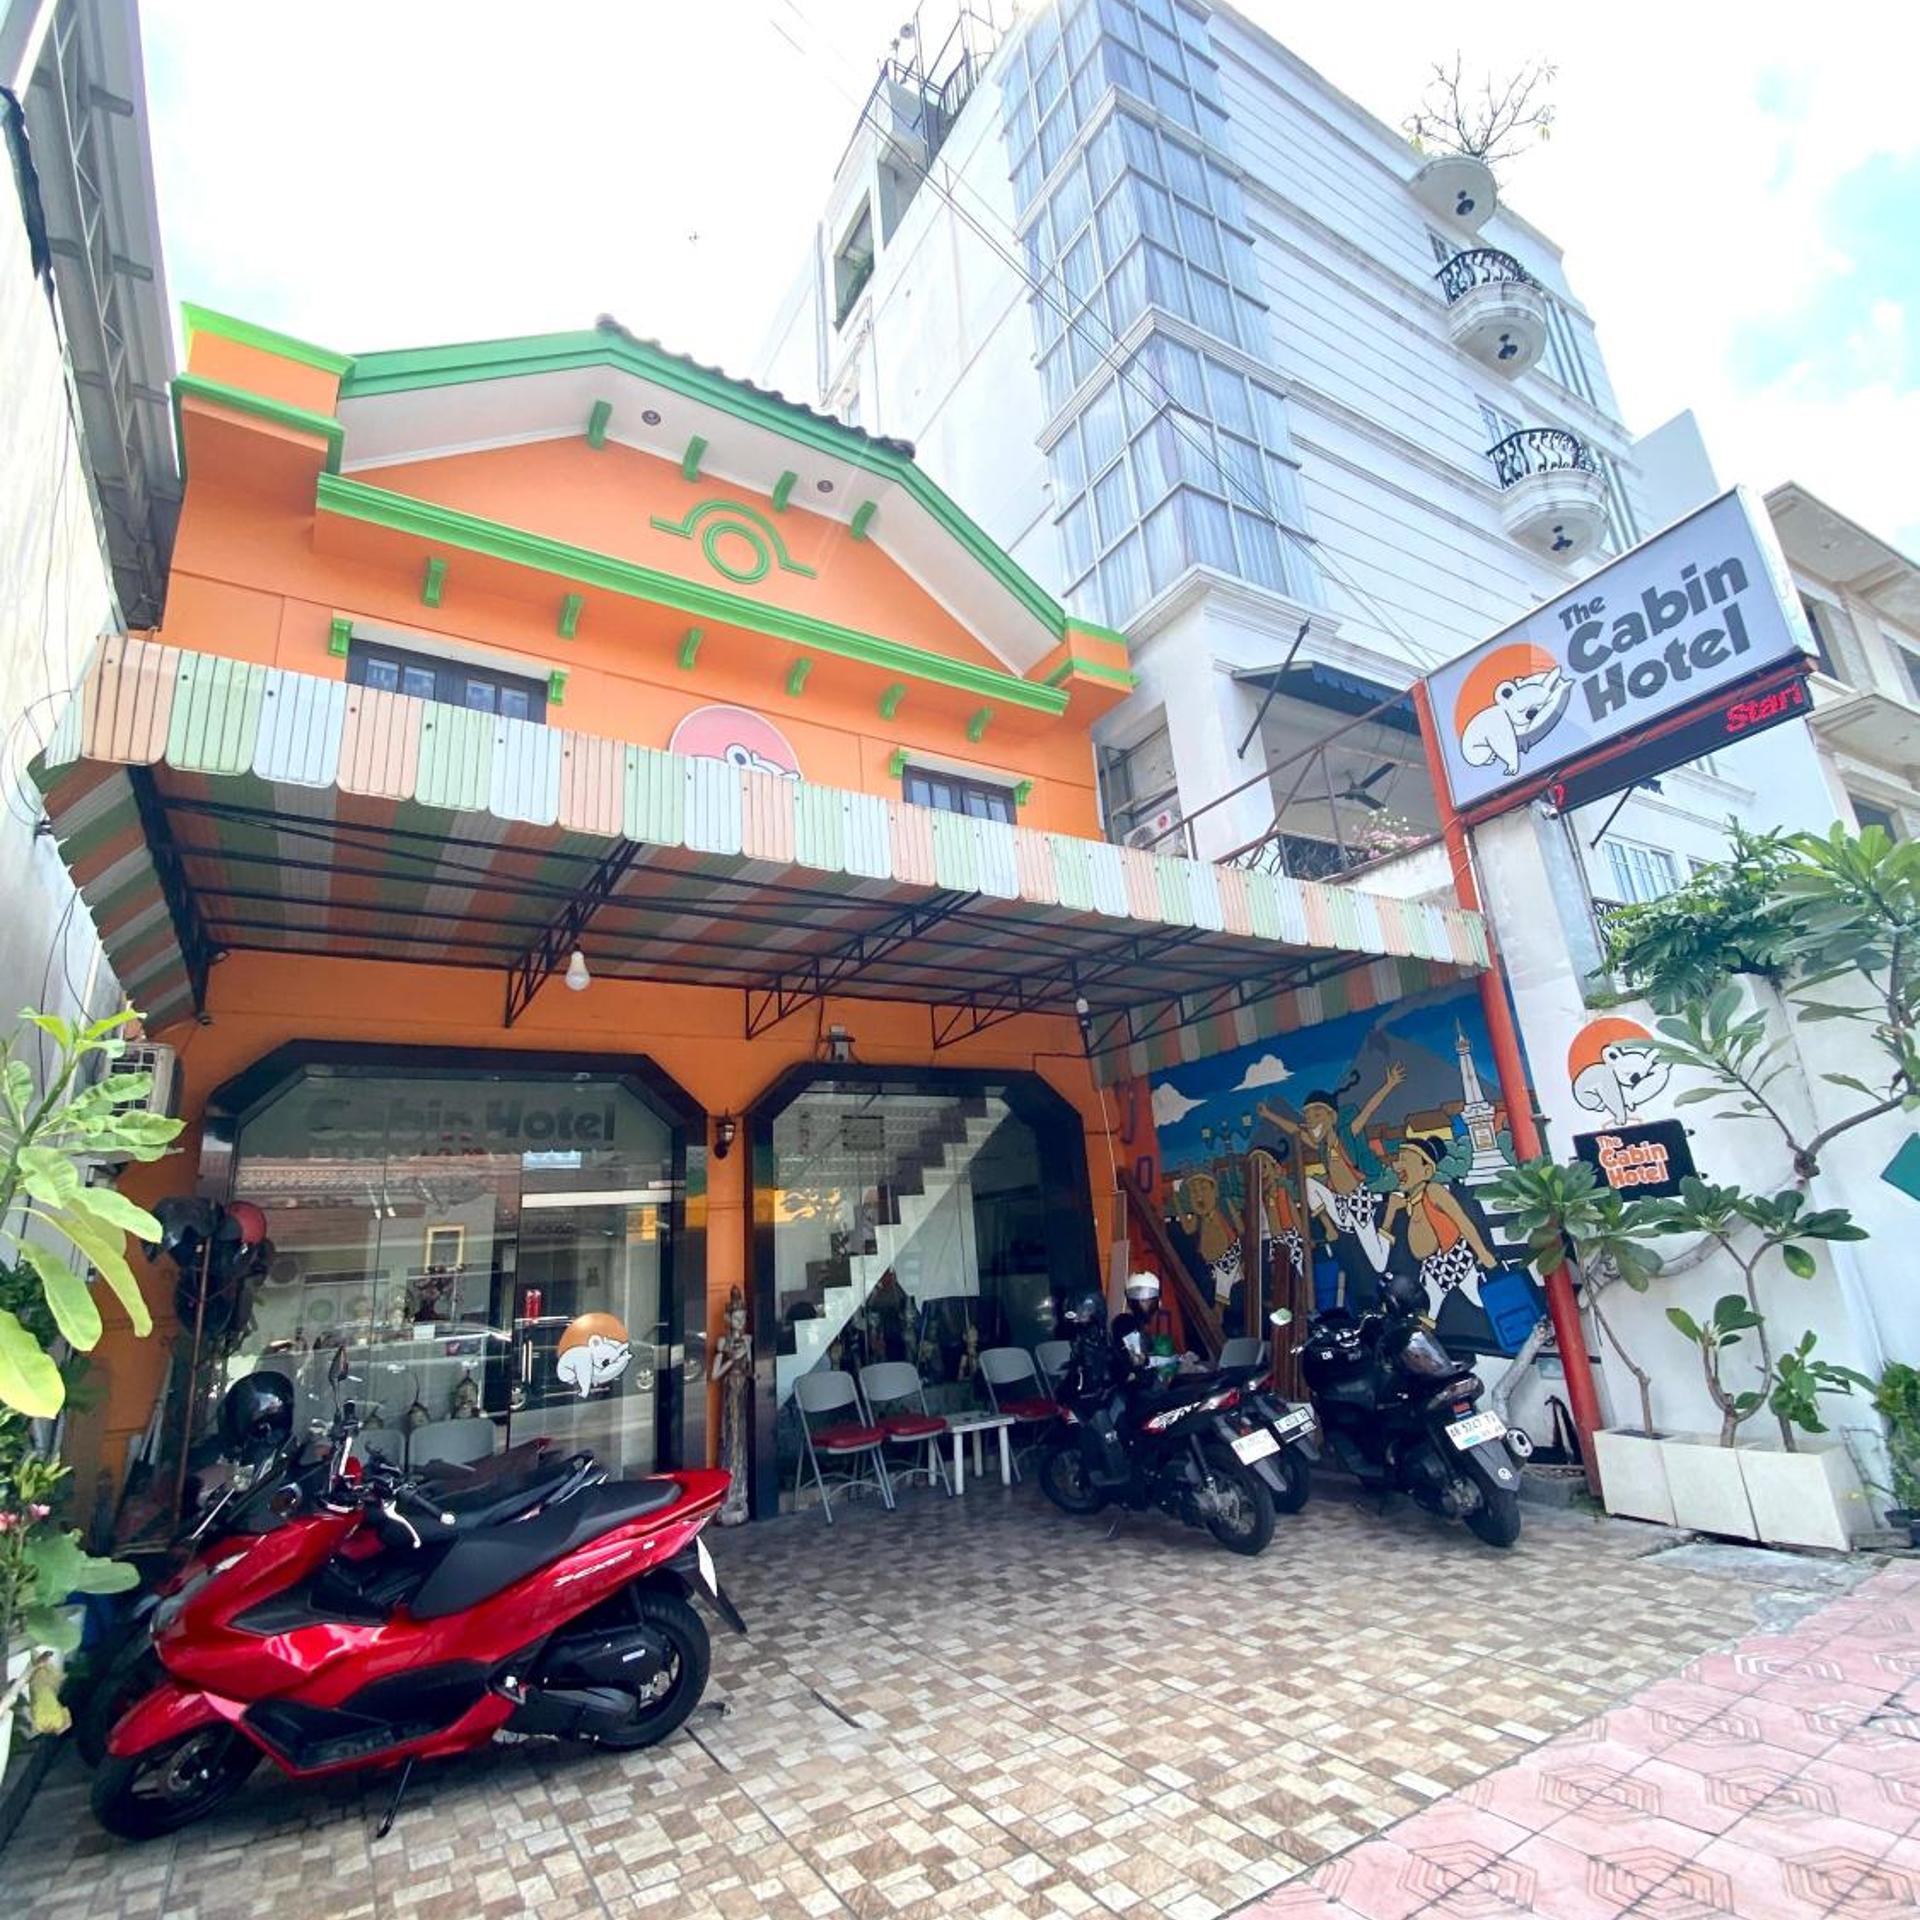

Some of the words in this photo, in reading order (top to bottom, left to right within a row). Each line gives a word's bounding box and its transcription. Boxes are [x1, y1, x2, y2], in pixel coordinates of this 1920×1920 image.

[1558, 596, 1606, 632] The
[1567, 557, 1749, 674] Cabin
[1582, 601, 1751, 723] Hotel
[486, 1099, 617, 1142] Hotel
[1596, 1135, 1624, 1150] The
[1599, 1141, 1669, 1169] Cabin
[1606, 1160, 1669, 1190] Hotel
